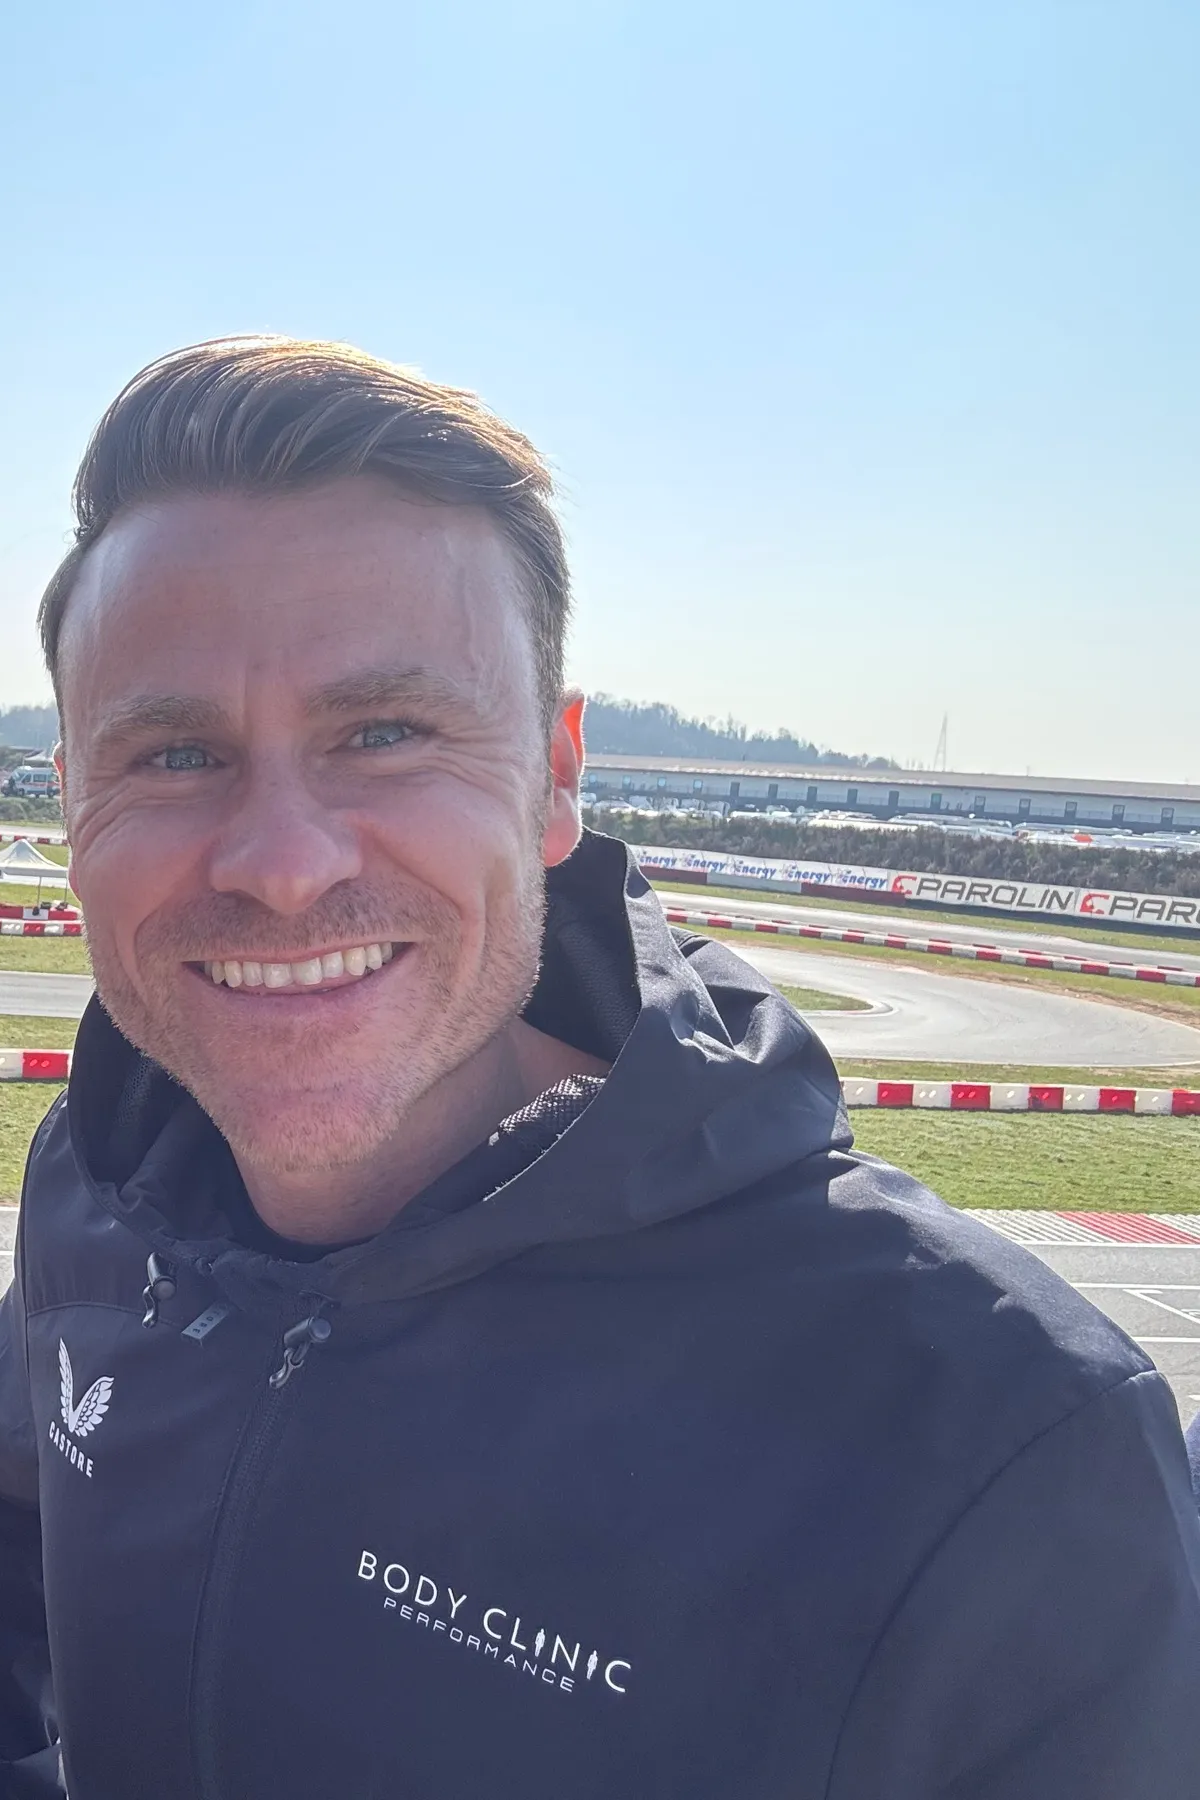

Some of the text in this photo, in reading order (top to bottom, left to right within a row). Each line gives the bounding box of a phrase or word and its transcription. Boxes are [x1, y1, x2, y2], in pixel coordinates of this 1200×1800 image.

[916, 877, 1074, 911] PAROLIN
[48, 1421, 94, 1478] CASTORE
[357, 1550, 632, 1693] BODY CLINIC
[383, 1597, 575, 1693] PERFORMANCE
